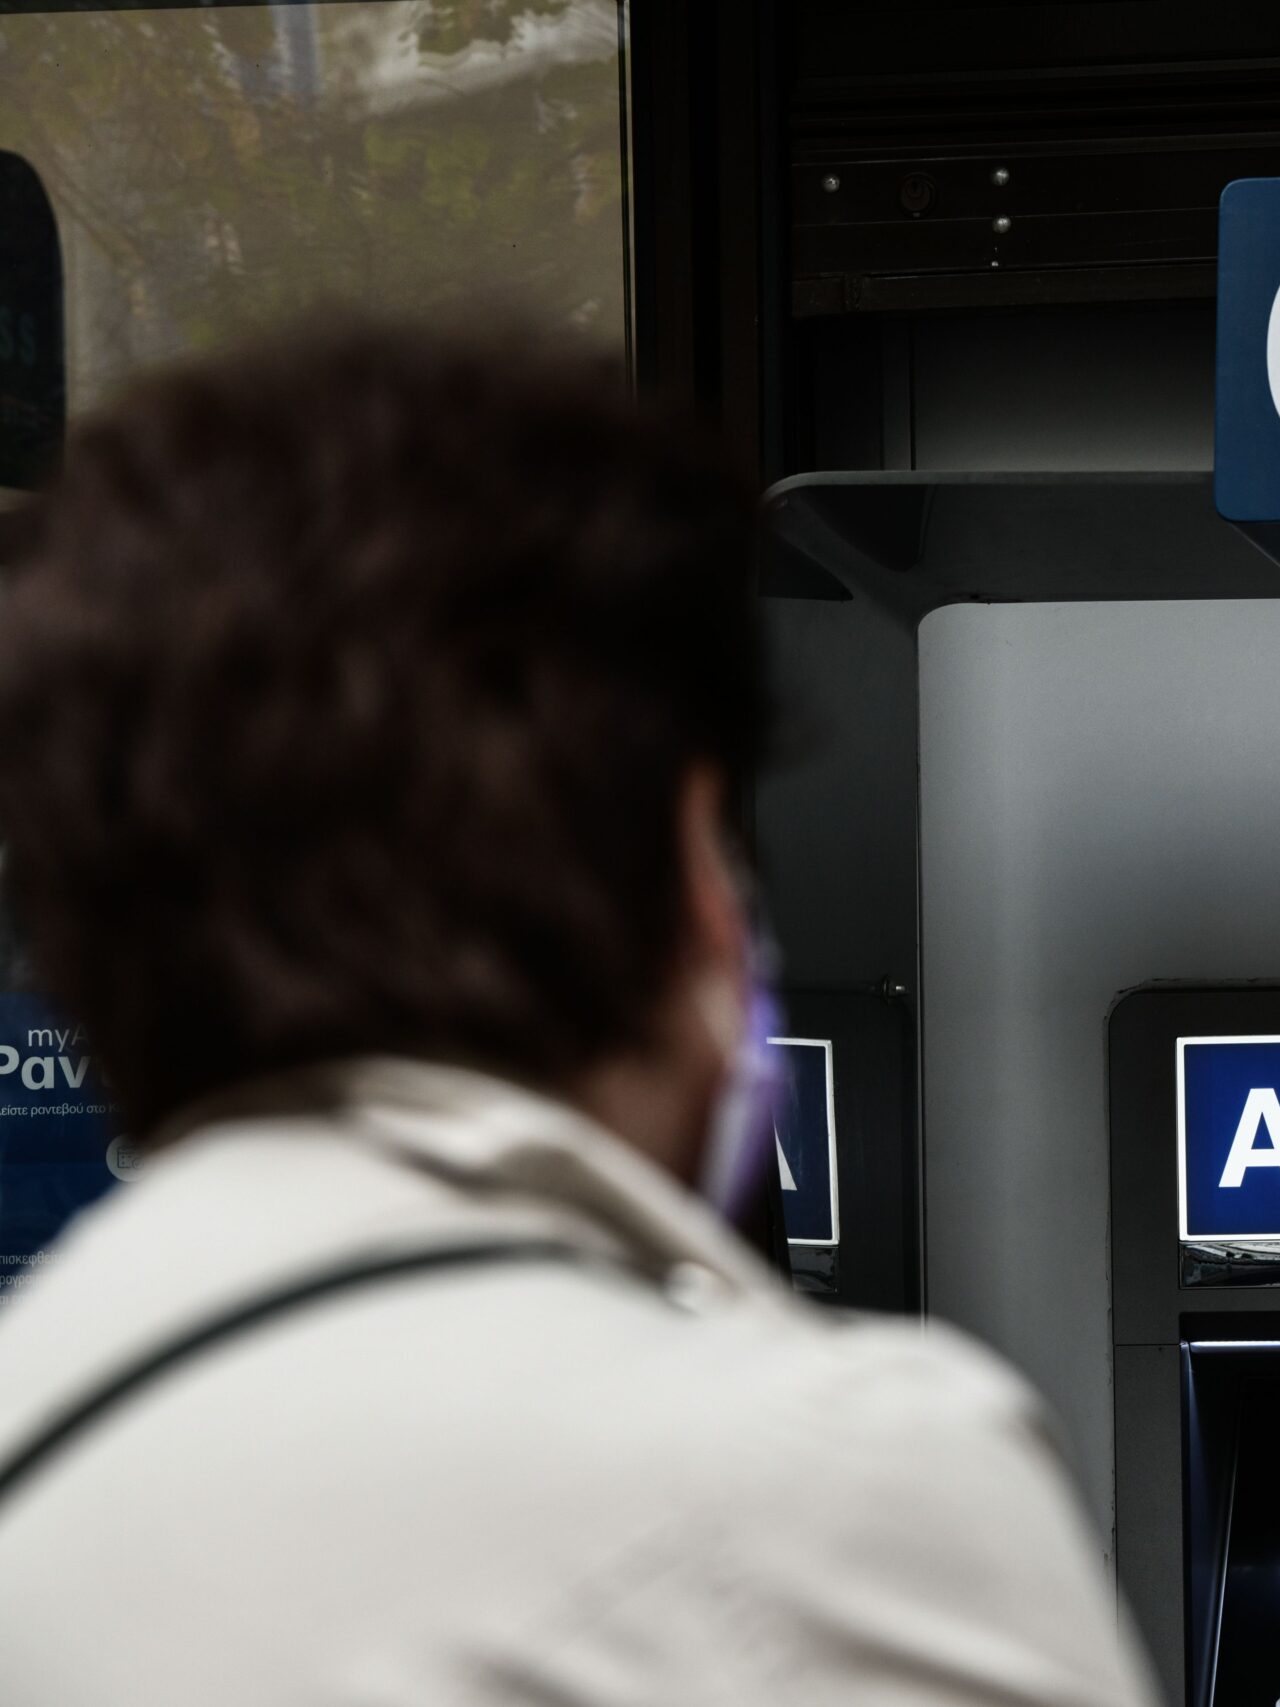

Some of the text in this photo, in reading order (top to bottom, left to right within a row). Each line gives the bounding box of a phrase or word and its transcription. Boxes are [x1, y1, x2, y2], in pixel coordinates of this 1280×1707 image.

[28, 1026, 89, 1053] myA
[0, 1104, 28, 1116] είστε
[30, 1102, 84, 1118] ραντεβού
